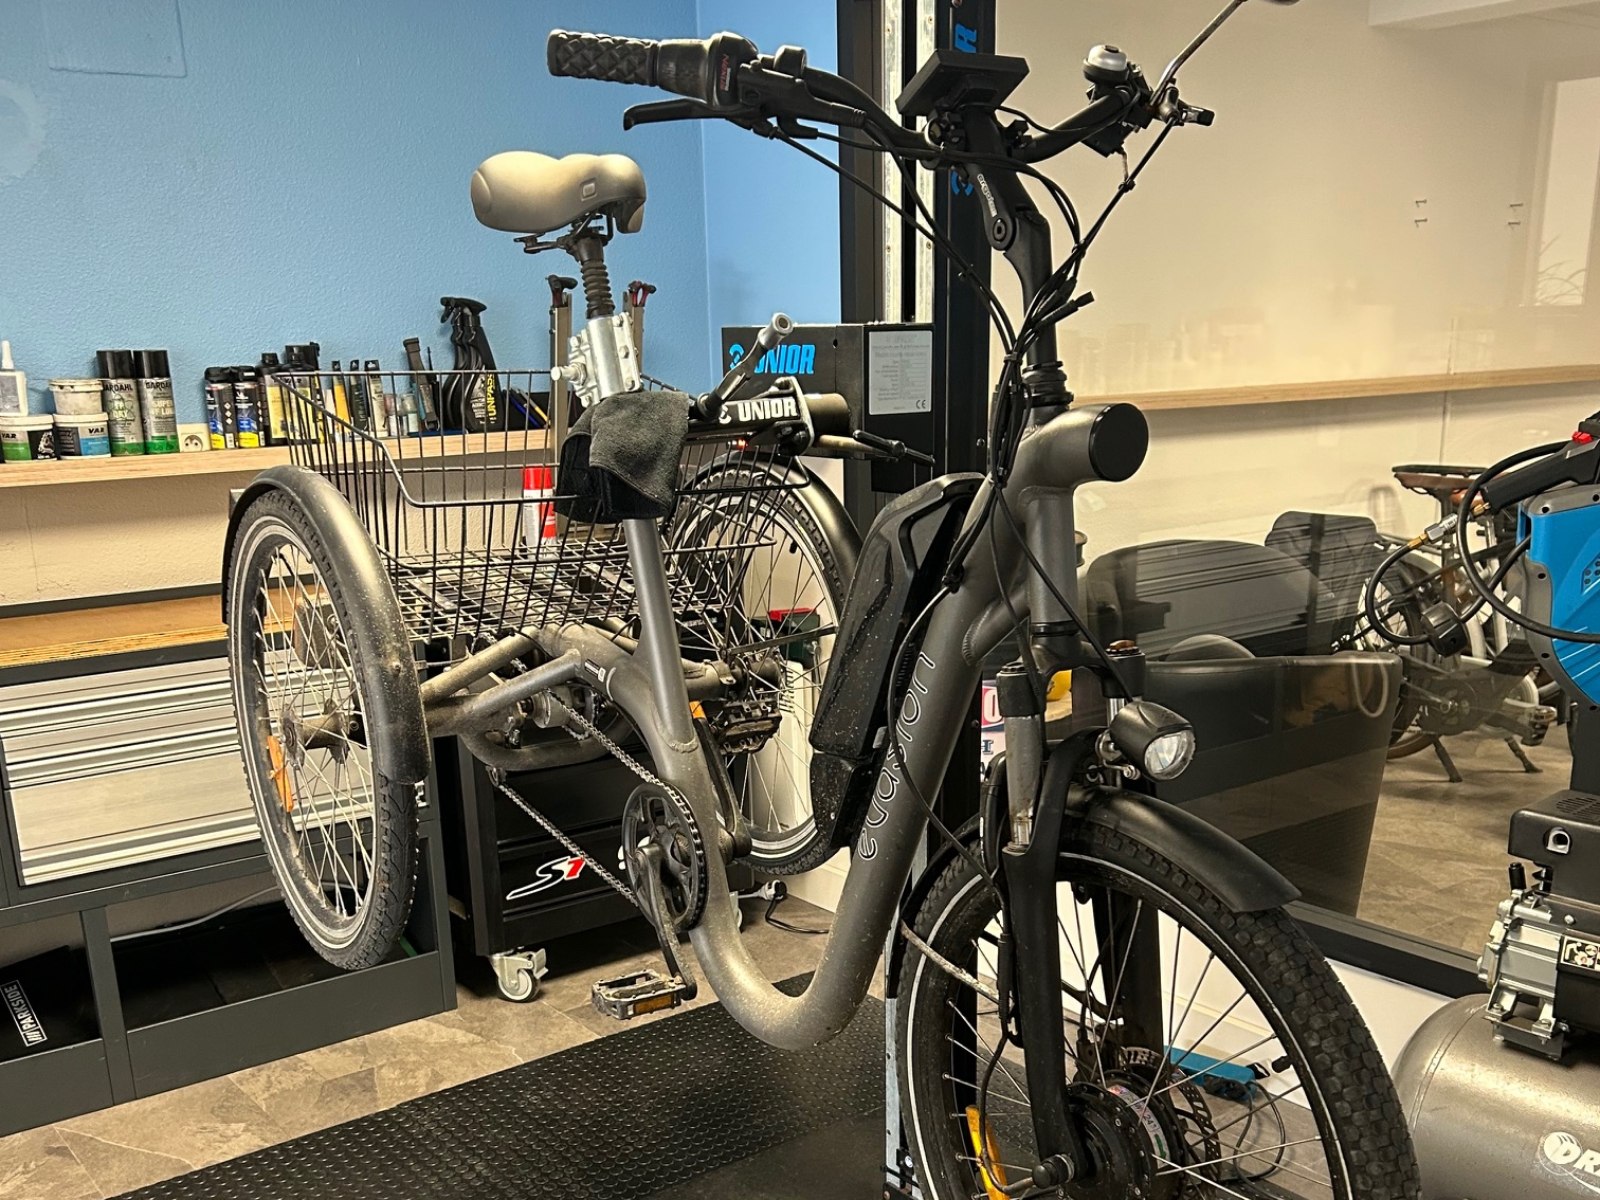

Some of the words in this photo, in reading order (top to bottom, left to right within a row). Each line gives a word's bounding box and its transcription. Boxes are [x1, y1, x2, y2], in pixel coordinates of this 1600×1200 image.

[738, 397, 798, 421] UNIOR
[858, 651, 936, 860] evasion
[4, 984, 37, 1031] PARKSIDE
